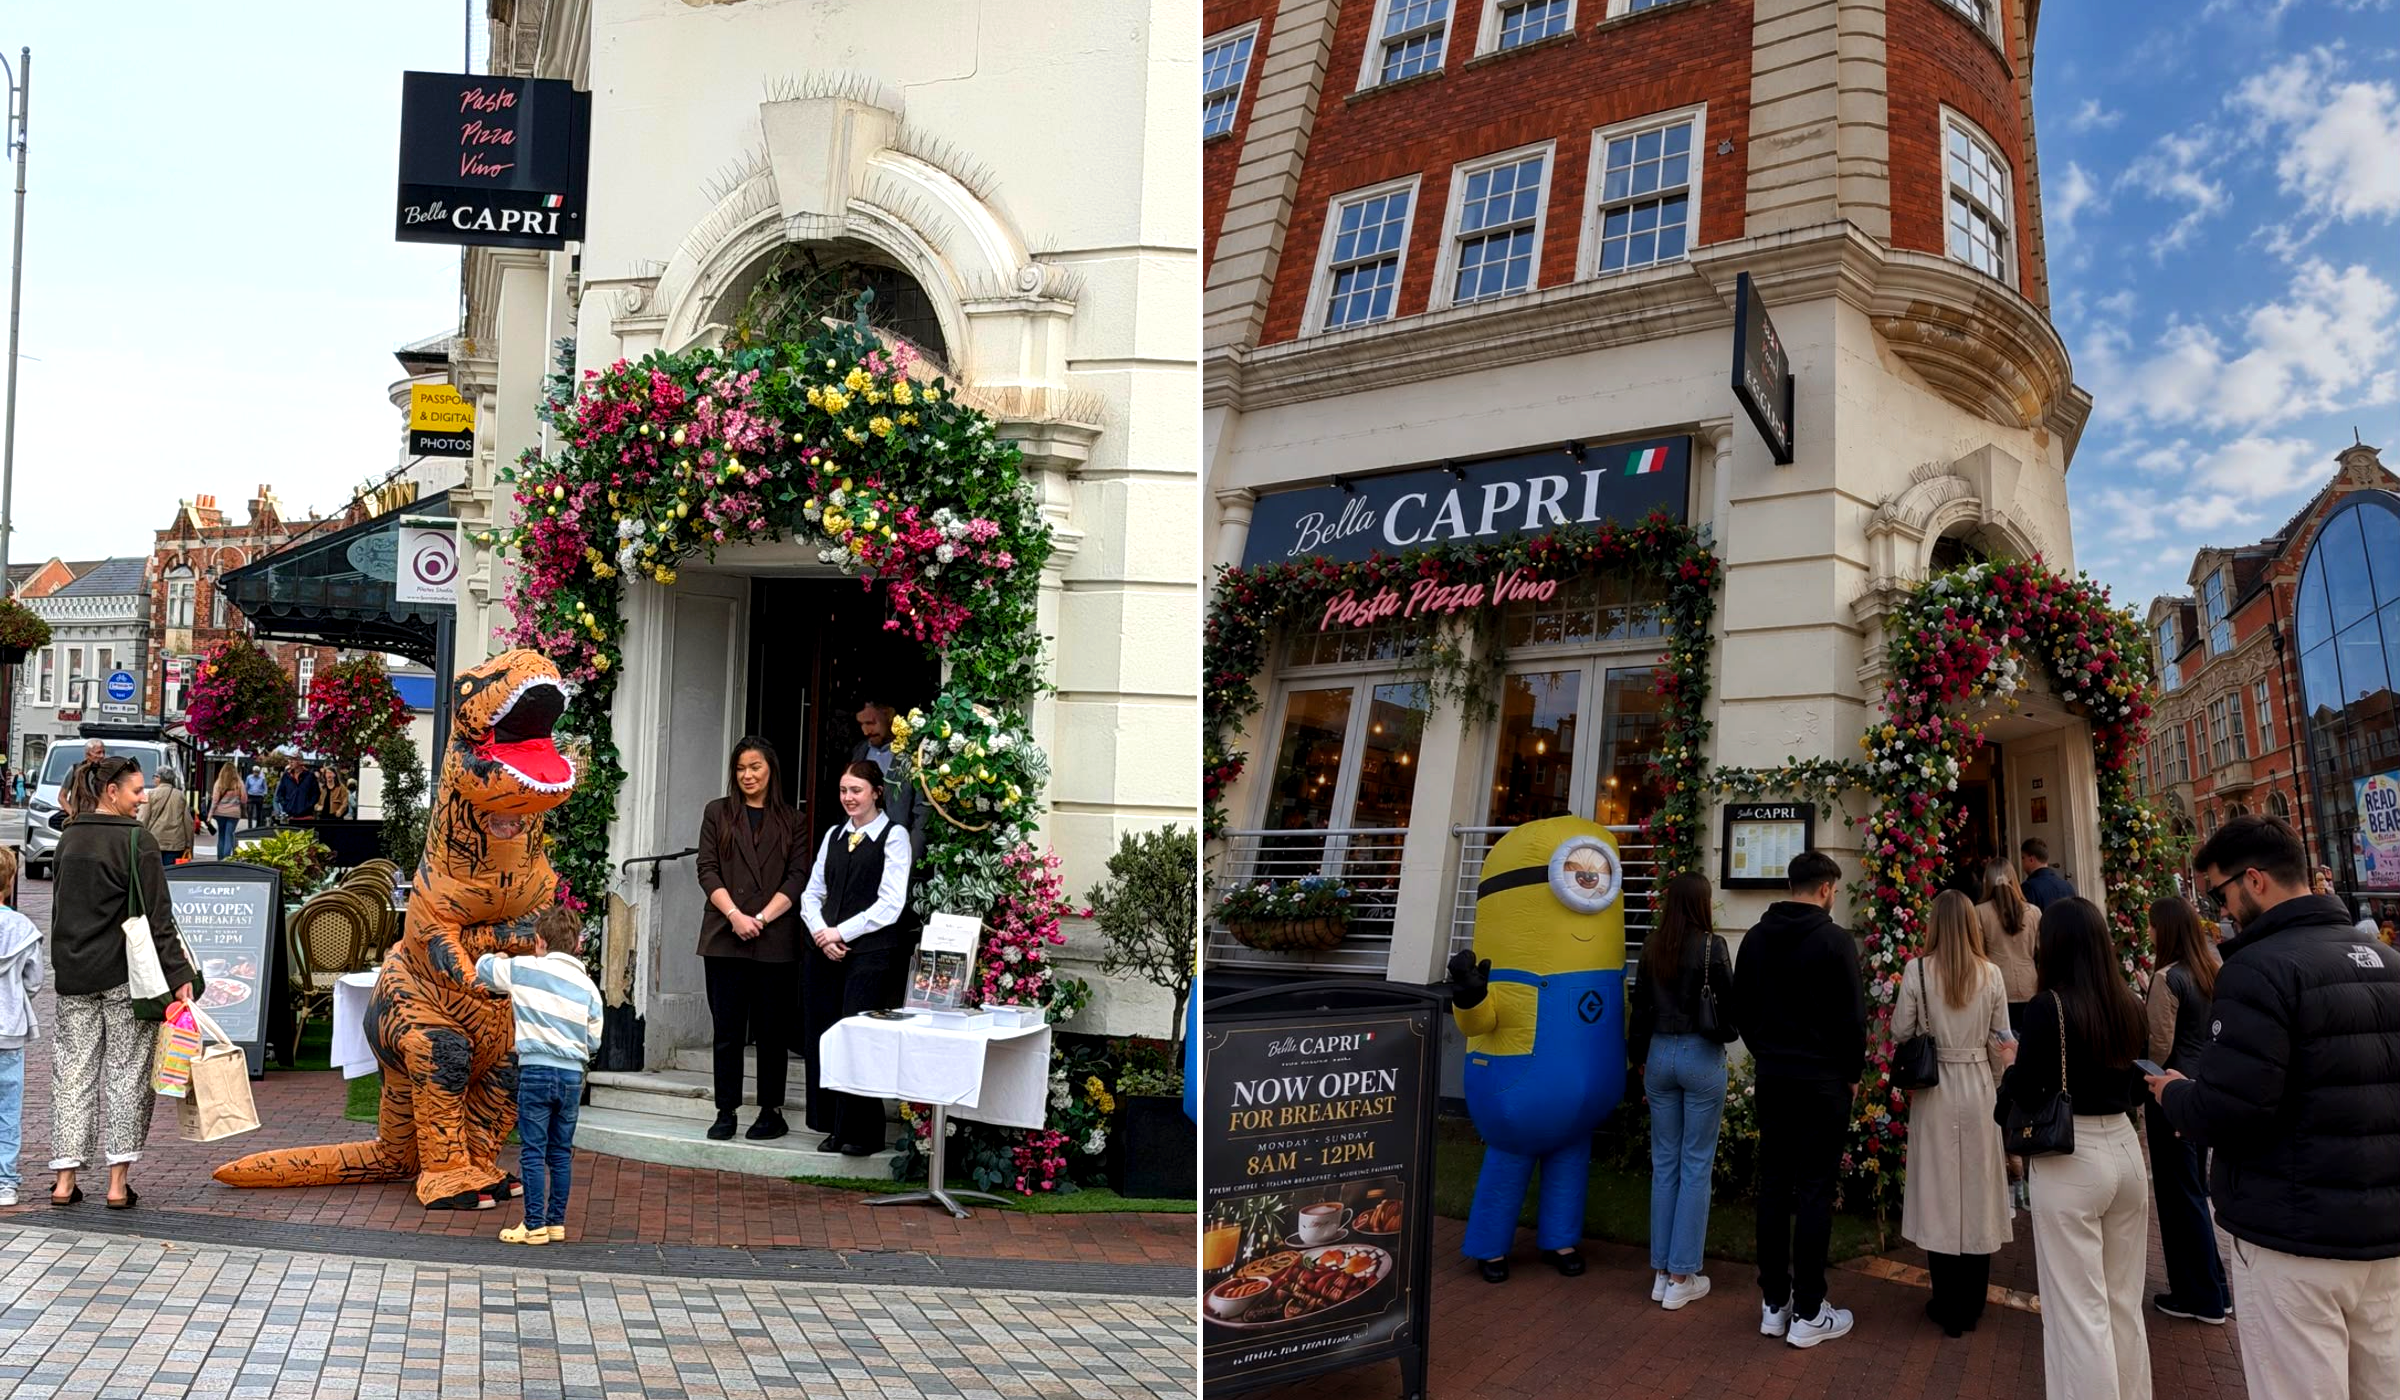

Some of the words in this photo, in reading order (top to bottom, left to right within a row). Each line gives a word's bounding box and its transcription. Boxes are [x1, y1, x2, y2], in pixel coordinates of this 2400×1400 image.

[460, 87, 518, 114] Pasta
[460, 120, 517, 146] Pizza
[460, 152, 515, 178] Vino
[404, 200, 448, 225] Bella
[452, 206, 560, 235] CAPRI
[420, 411, 428, 421] &
[430, 412, 475, 423] DIGITAL
[420, 437, 472, 450] PHOTOS
[1287, 494, 1376, 557] Bella
[1382, 468, 1607, 546] CAPRI
[1320, 585, 1402, 631] Pasta
[1404, 577, 1485, 614] Pizza
[1491, 567, 1557, 606] Vino
[2365, 788, 2397, 812] READ
[1754, 807, 1795, 819] CAPRI
[203, 887, 235, 895] CAPRI
[173, 902, 211, 915] NOW
[213, 903, 254, 915] OPEN
[177, 915, 192, 924] OR
[195, 915, 254, 925] BREAKFAST
[215, 934, 243, 943] 12PM
[1300, 1034, 1361, 1055] CAPRI
[1231, 1075, 1314, 1107] NOW
[1318, 1068, 1399, 1099] OPEN
[1229, 1109, 1273, 1131] FOR
[1279, 1096, 1396, 1127] BREAKFAST
[1257, 1138, 1309, 1151] MONDAY
[1324, 1131, 1369, 1144] SUNDAY
[1246, 1151, 1296, 1176] 8AM
[1320, 1141, 1375, 1166] 12PM
